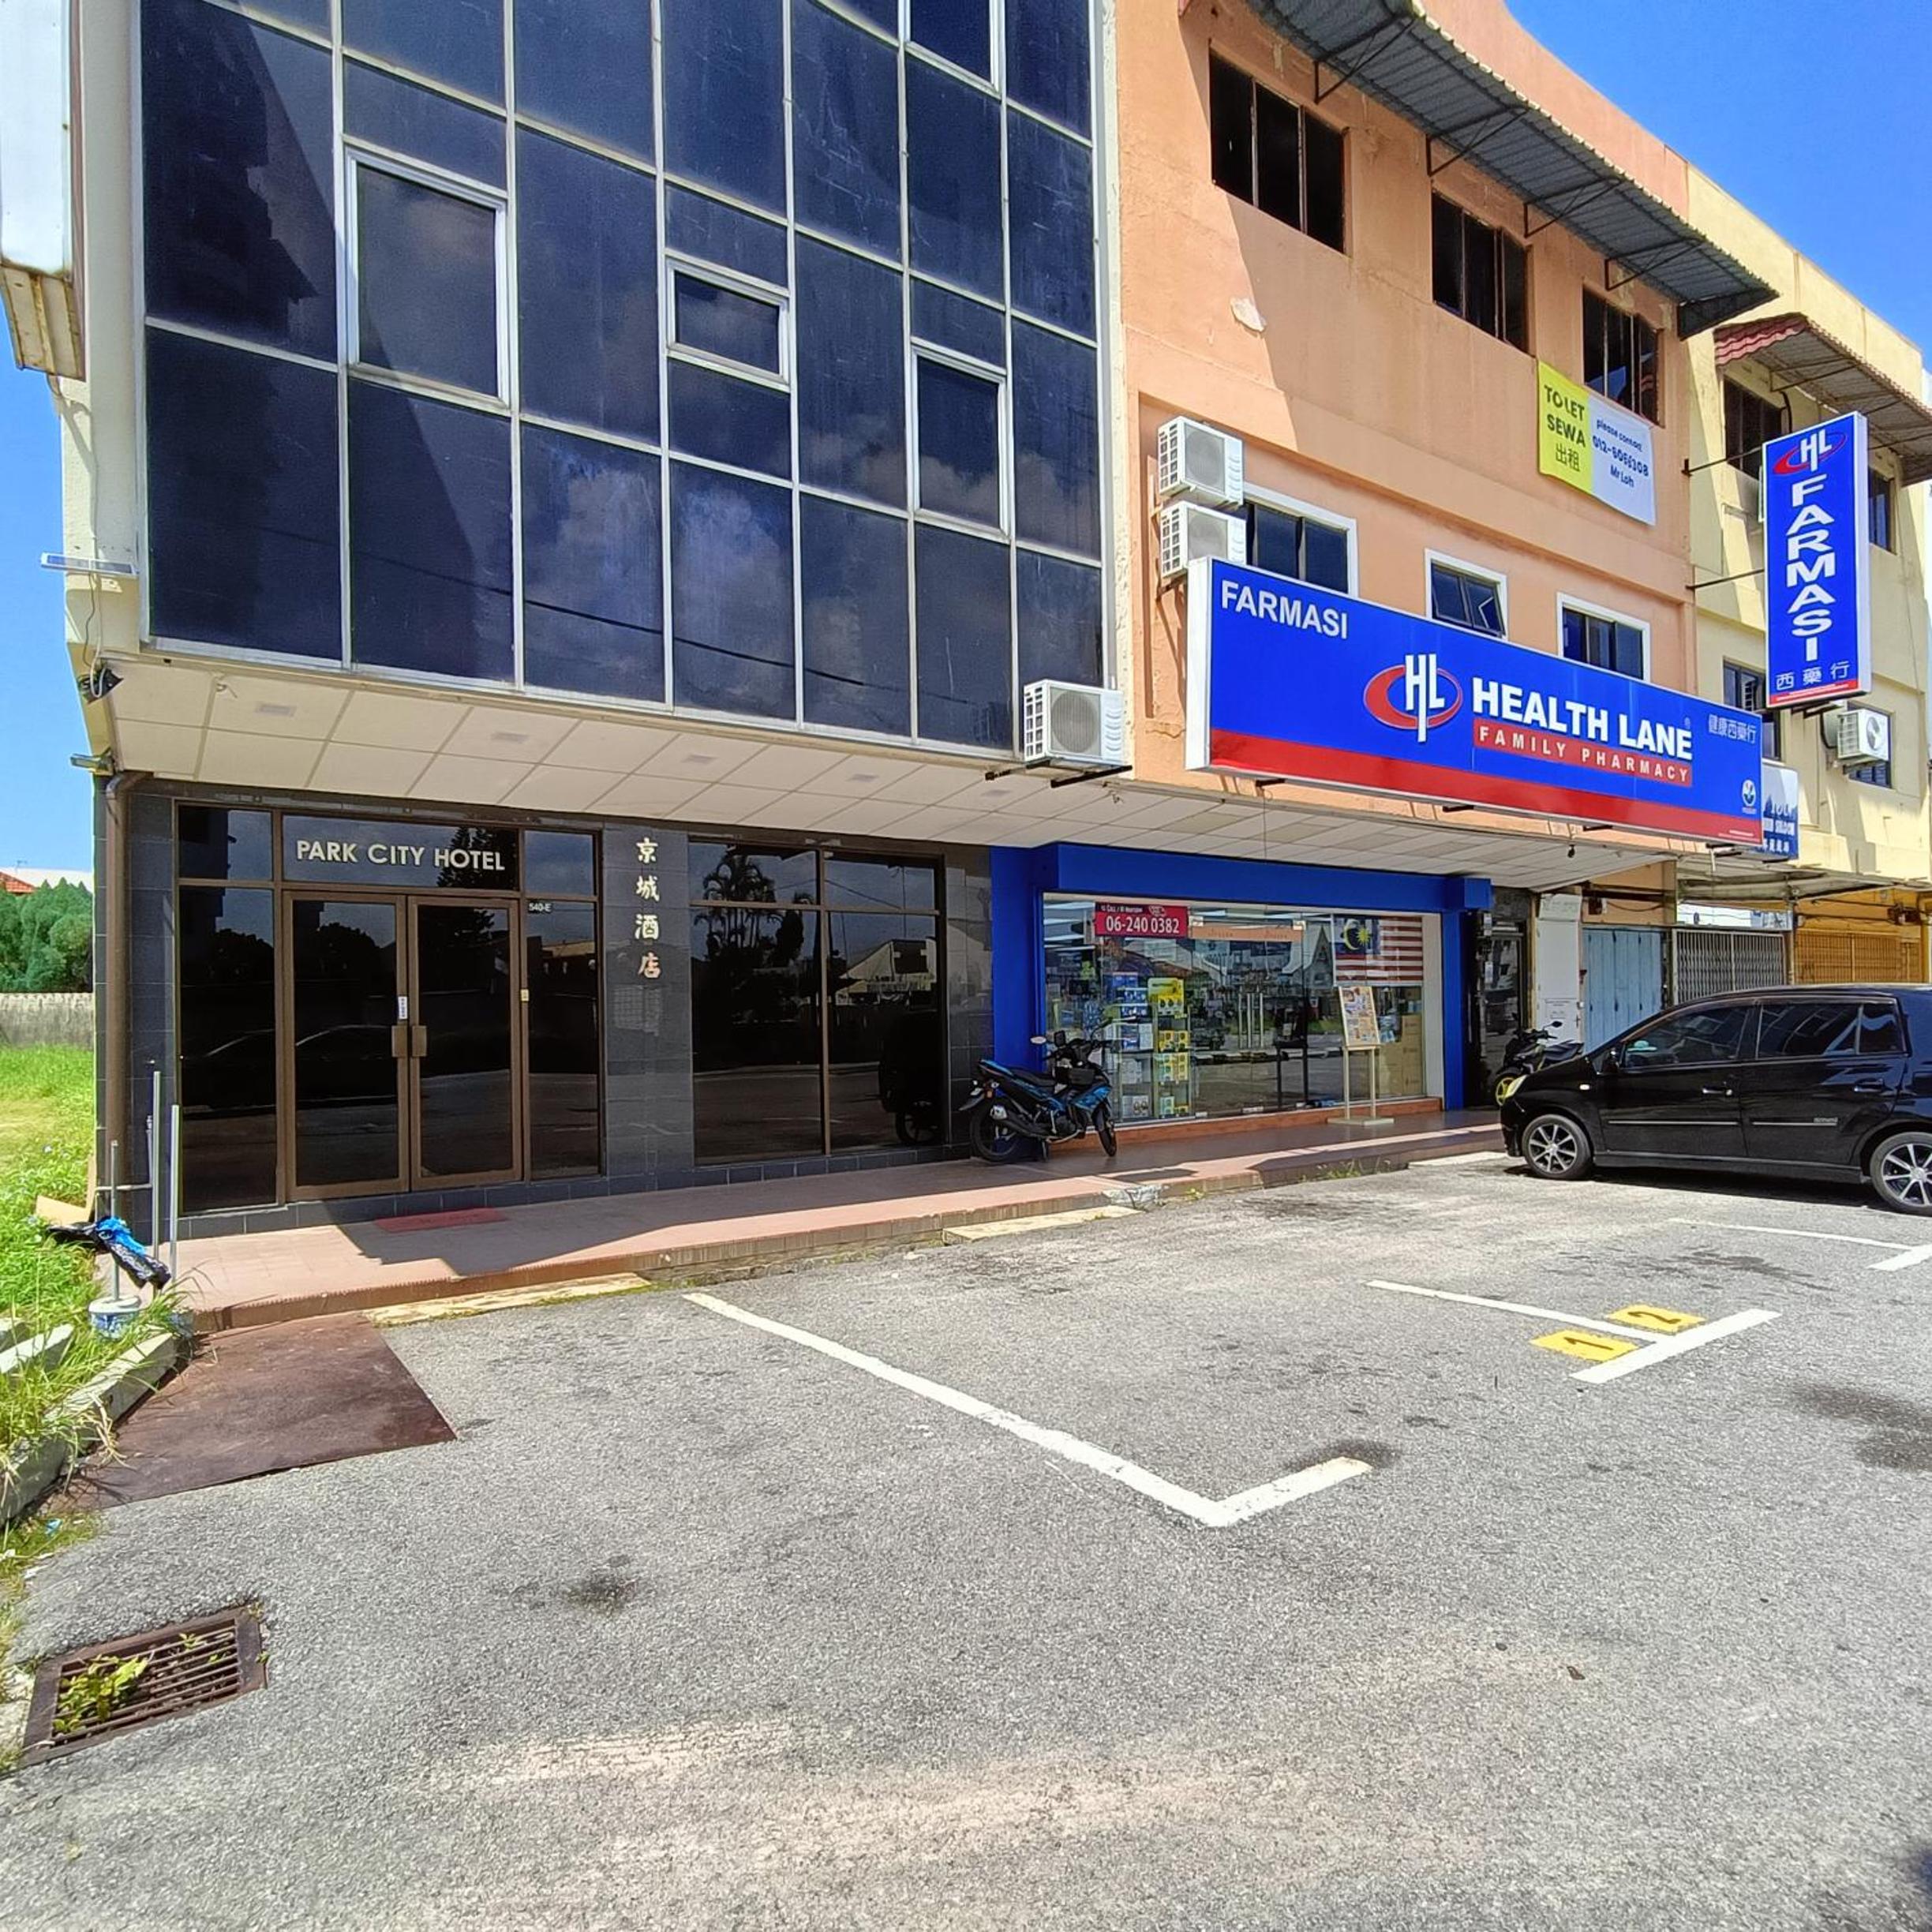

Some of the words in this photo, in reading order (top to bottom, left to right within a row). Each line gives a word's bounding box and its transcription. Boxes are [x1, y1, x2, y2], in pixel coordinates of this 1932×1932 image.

[1547, 414, 1586, 447] SEWA
[1799, 429, 1832, 472] HL
[1555, 443, 1581, 473] 出租
[1786, 474, 1836, 661] FARMASI
[1222, 579, 1347, 639] FARMASI
[1405, 653, 1446, 743] HL
[1472, 676, 1608, 743] HEALTH
[1619, 713, 1693, 761] LANE
[1479, 725, 1567, 758] FAMILY
[1582, 748, 1690, 782] PHARMACY
[296, 840, 358, 863] PARK
[367, 844, 425, 867] CITY
[435, 848, 506, 871] HOTEL
[635, 837, 661, 979] 京城酒店
[1106, 915, 1148, 933] 06-240
[1151, 917, 1180, 934] 0382
[1627, 1310, 1682, 1325] 2
